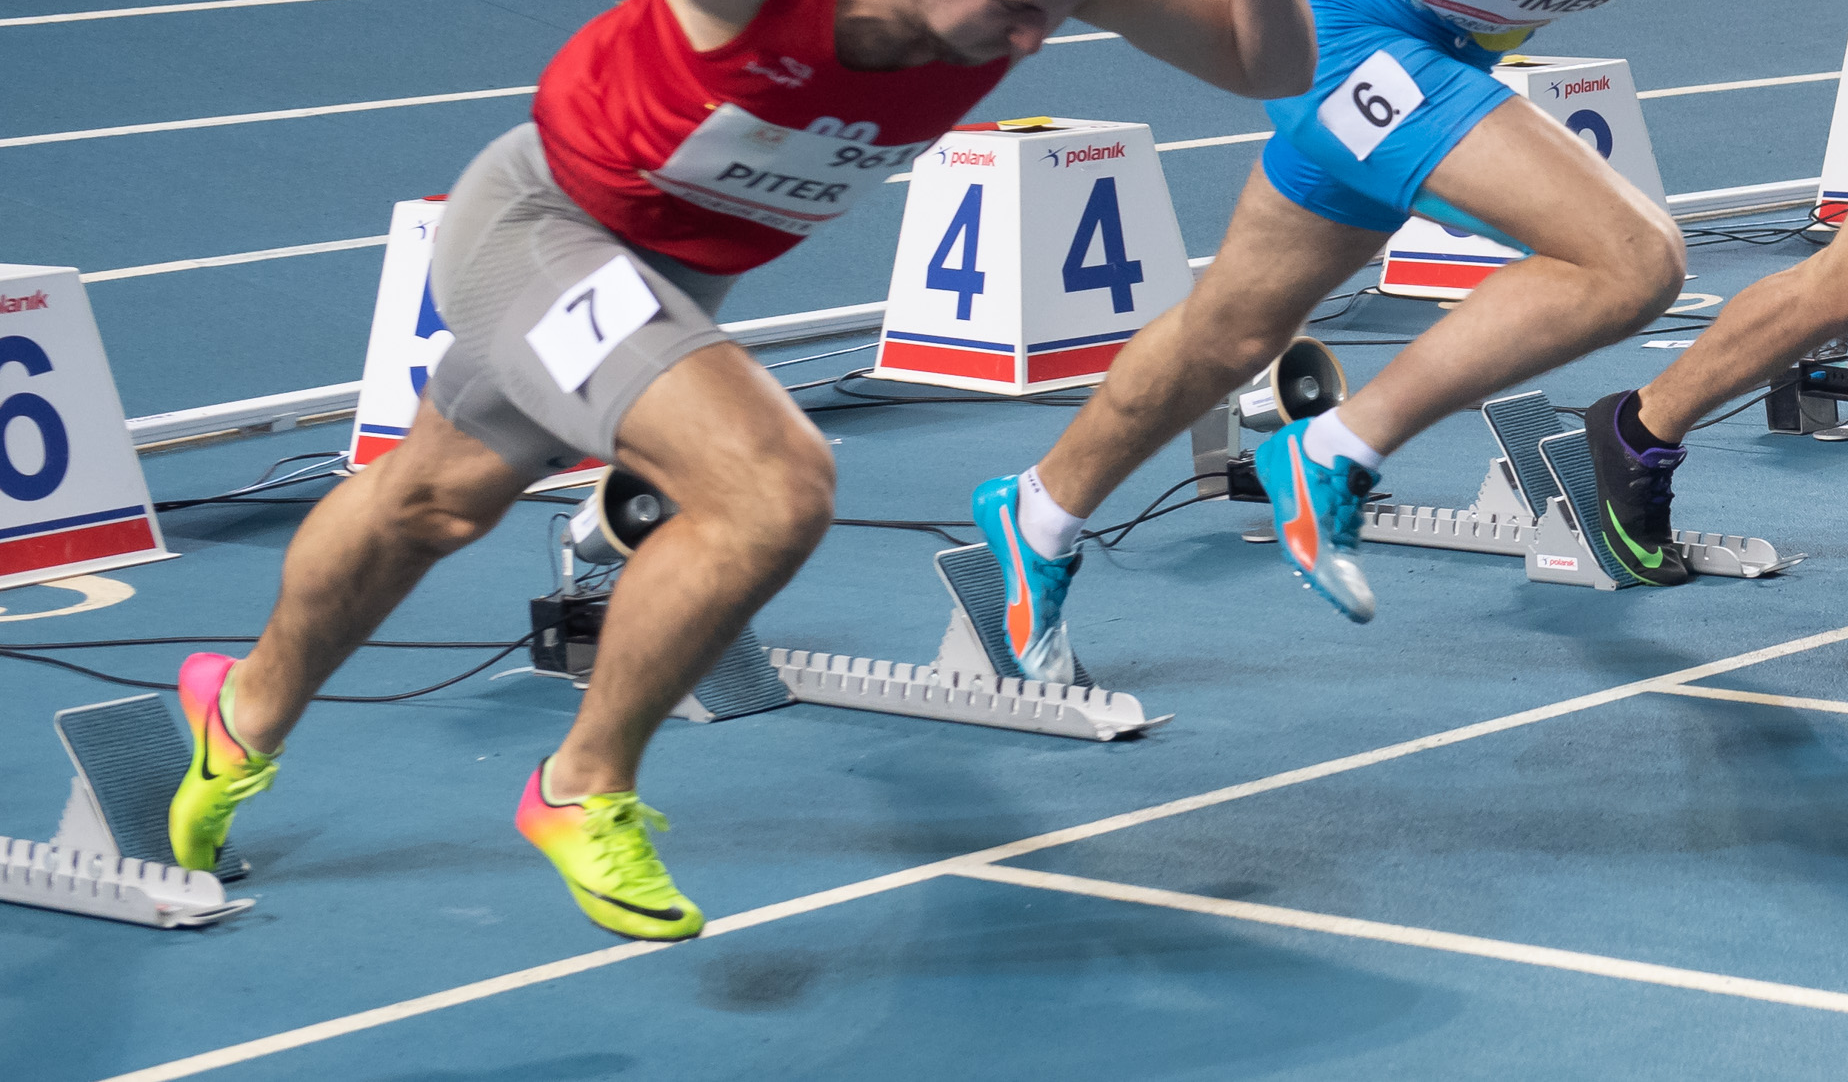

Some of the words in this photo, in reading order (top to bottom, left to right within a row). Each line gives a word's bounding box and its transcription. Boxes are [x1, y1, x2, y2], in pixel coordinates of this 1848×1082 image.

[1564, 75, 1611, 99] polanik
[950, 148, 996, 168] polanik
[1065, 141, 1127, 168] polanik
[715, 161, 849, 203] PITER
[926, 183, 986, 321] 4
[1062, 176, 1145, 314] 4
[566, 287, 606, 344] 7
[0, 335, 70, 502] 6
